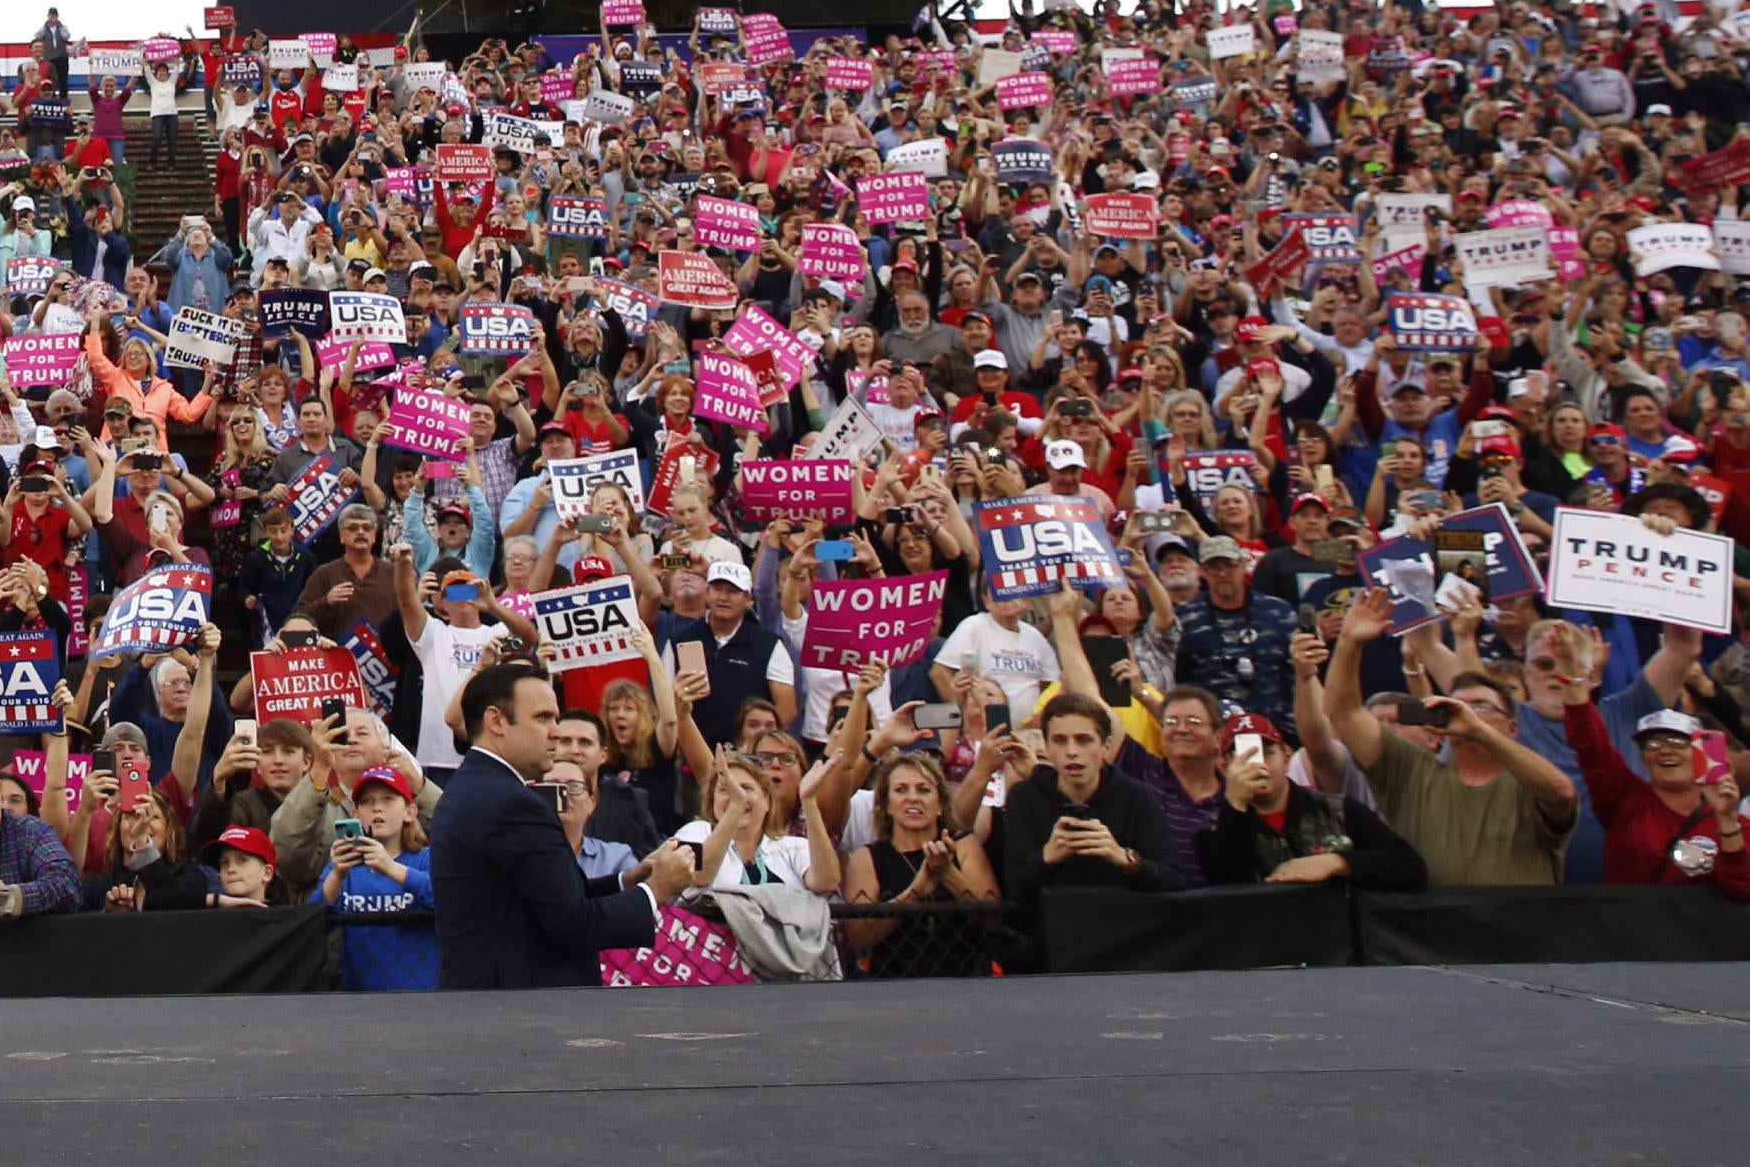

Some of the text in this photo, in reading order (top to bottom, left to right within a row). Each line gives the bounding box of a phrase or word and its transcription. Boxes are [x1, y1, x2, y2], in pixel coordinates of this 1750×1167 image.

[723, 89, 764, 103] USA
[497, 122, 533, 139] USA
[857, 175, 925, 192] WOMEN
[553, 207, 603, 223] USA
[698, 199, 759, 220] WOMEN
[863, 204, 924, 221] TRUMP
[700, 229, 755, 247] TRUMP
[804, 229, 860, 246] WOMEN
[8, 265, 56, 281] USA
[803, 259, 858, 274] TRUMP
[662, 270, 726, 284] AMERIC
[182, 309, 214, 325] SUCK
[338, 305, 397, 322] USA
[1395, 309, 1473, 329] USA
[466, 317, 528, 336] USA
[8, 338, 79, 351] WOMEN
[722, 384, 747, 399] FOR
[396, 390, 470, 421] WOMEN
[416, 415, 444, 430] FOR
[394, 427, 460, 452] TRUMP
[743, 466, 850, 483] WOMEN
[294, 473, 338, 523] USA
[779, 489, 815, 502] FOR
[990, 522, 1105, 563] USA
[1569, 538, 1718, 574] TRUMP
[1578, 560, 1701, 587] PENCE
[814, 578, 945, 612] WOMEN
[71, 570, 87, 649] TRUMP
[108, 591, 207, 627] USA
[546, 606, 630, 639] USA
[859, 622, 904, 639] FOR
[258, 672, 359, 696] AMERICA
[266, 699, 317, 712] GREAT
[343, 892, 413, 912] TRUMP
